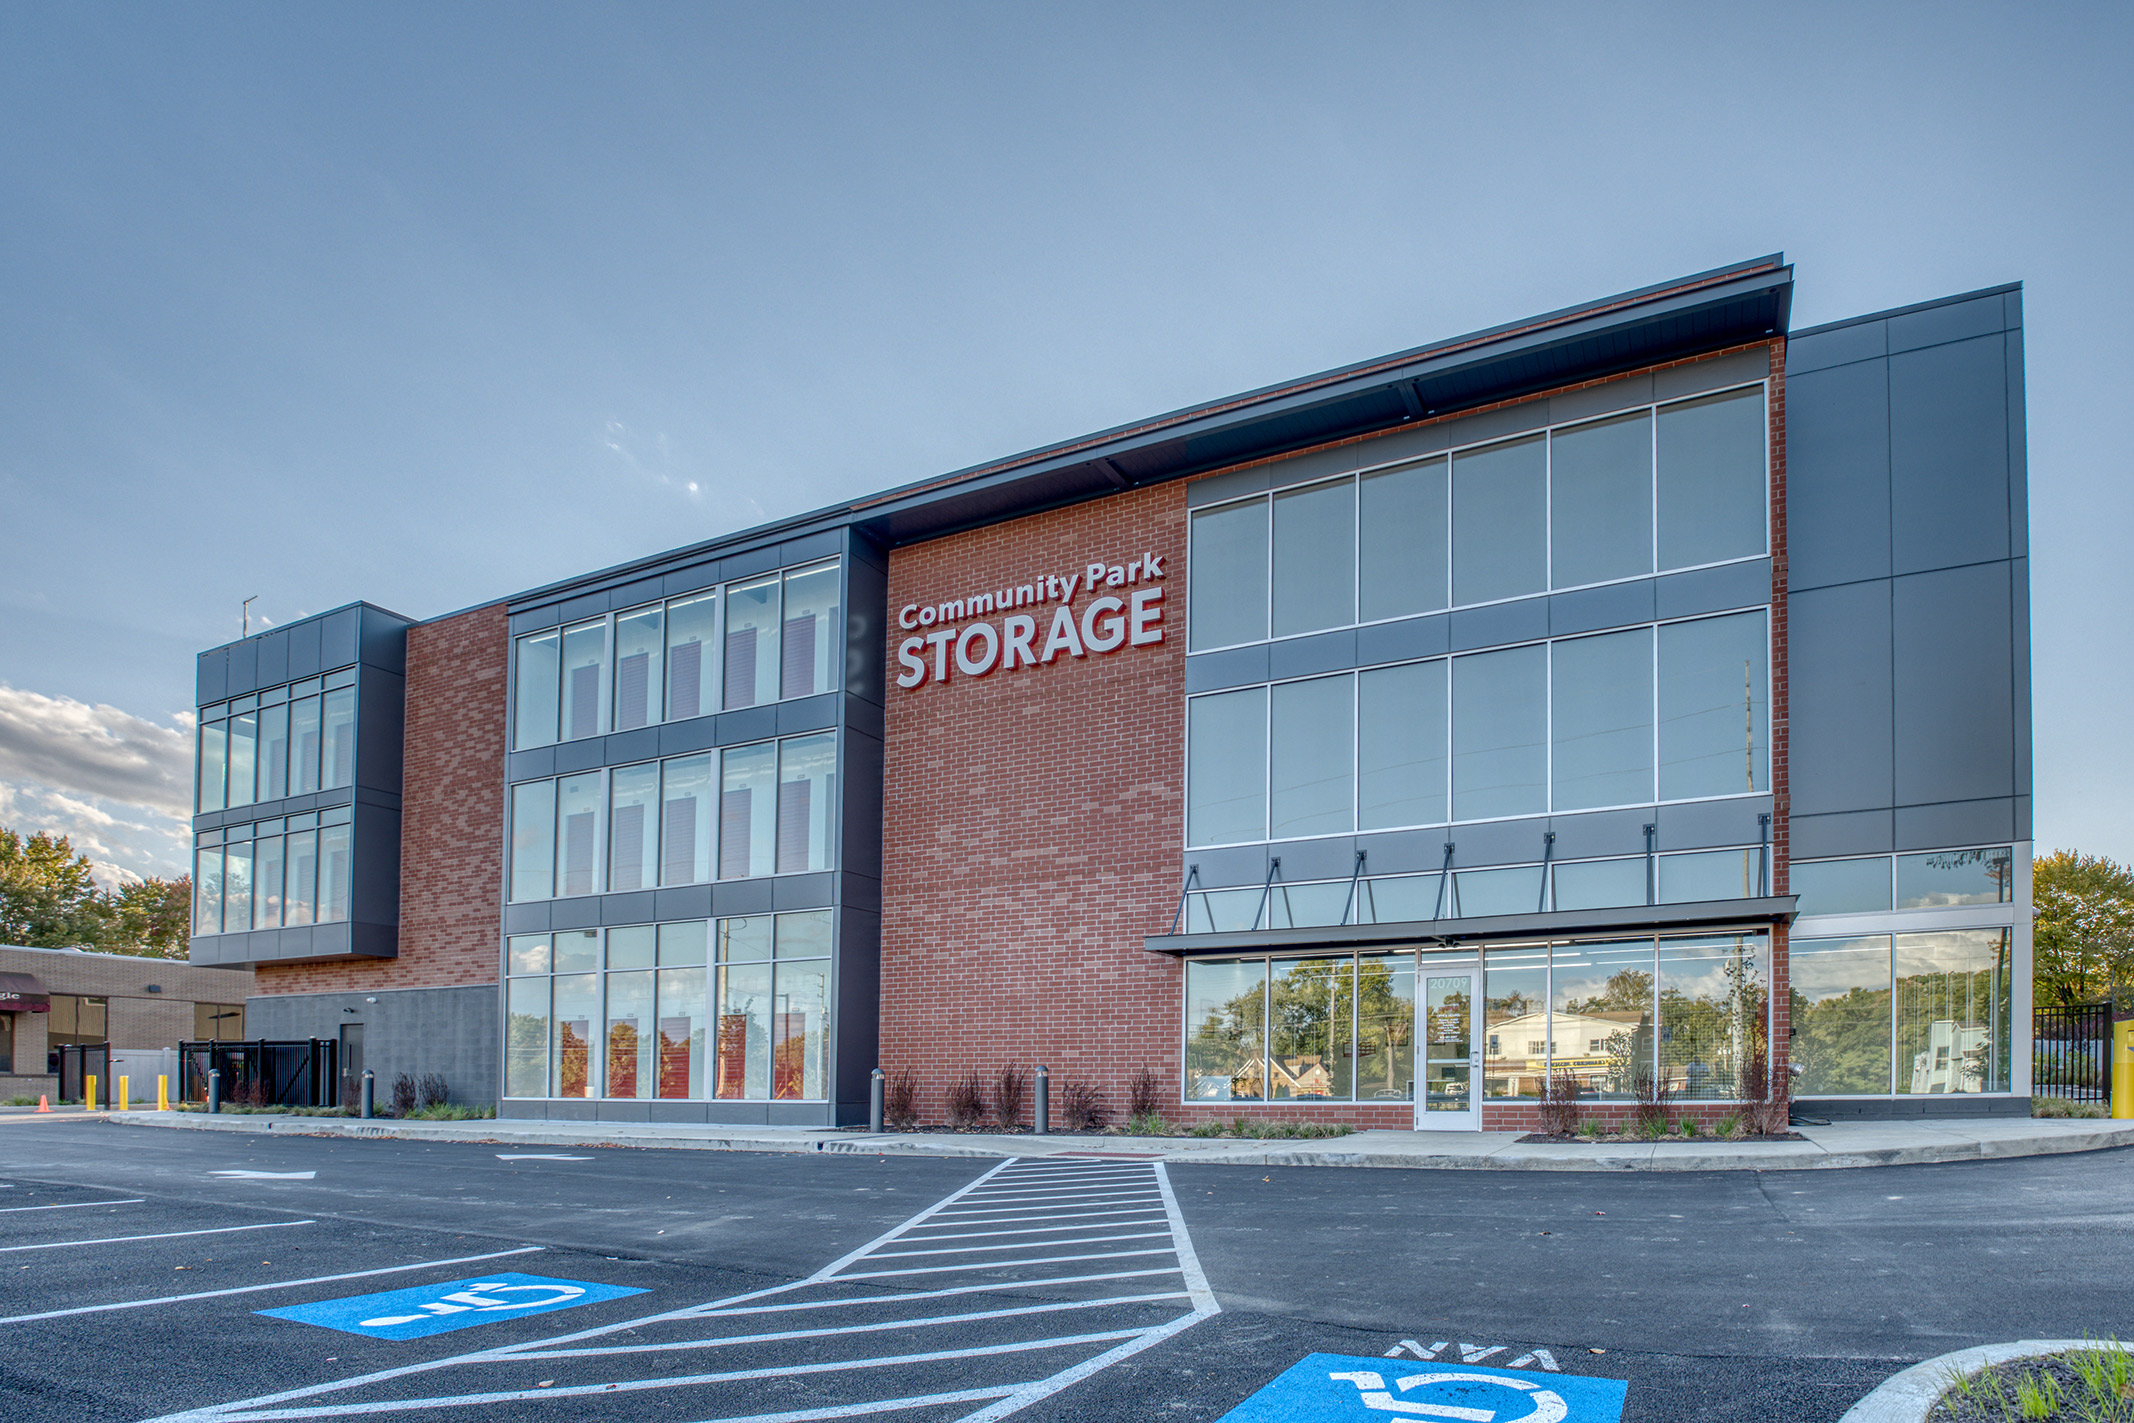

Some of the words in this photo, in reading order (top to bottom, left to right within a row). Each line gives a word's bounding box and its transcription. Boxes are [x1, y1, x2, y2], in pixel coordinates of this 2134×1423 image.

[898, 573, 1082, 631] Community
[1086, 551, 1167, 593] Park
[896, 586, 1166, 690] STORAGE
[1430, 977, 1468, 989] 20709
[1383, 1339, 1561, 1372] VAN
